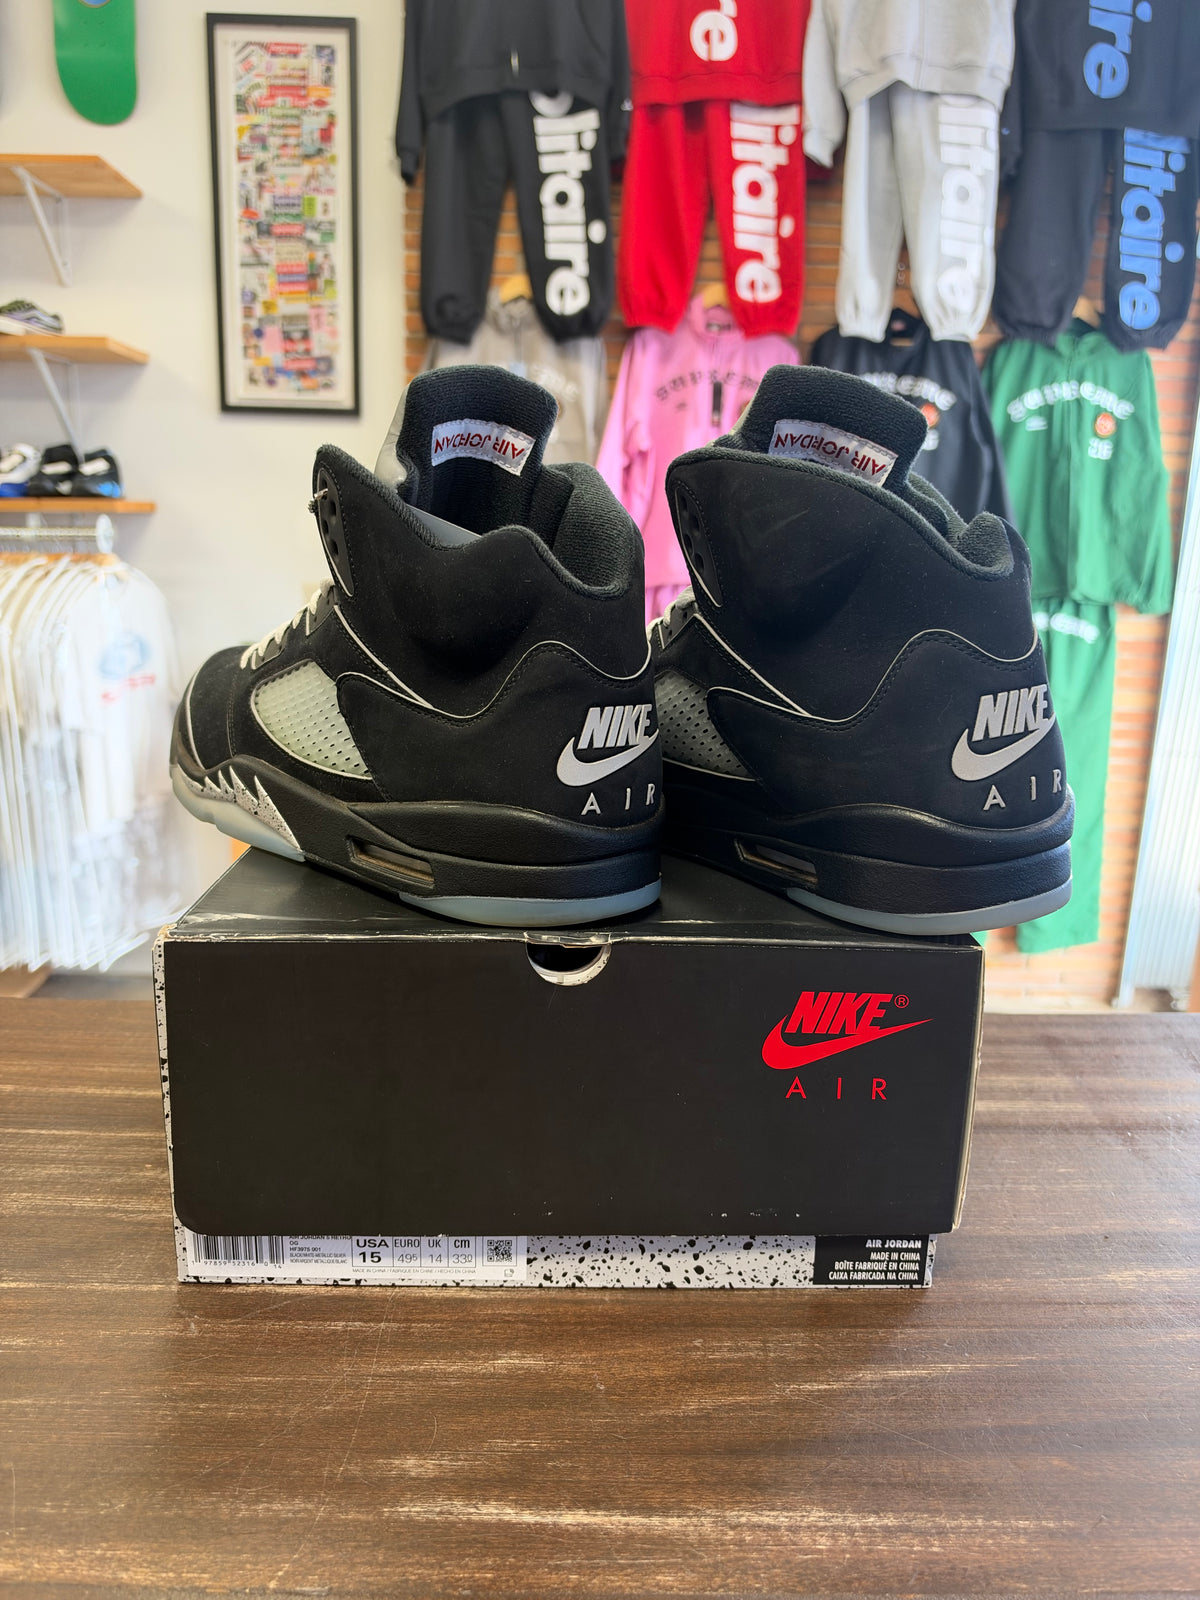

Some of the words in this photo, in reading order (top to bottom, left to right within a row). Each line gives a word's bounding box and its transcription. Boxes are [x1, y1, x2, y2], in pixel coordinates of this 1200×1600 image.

[434, 433, 491, 454] JORDAN
[492, 437, 525, 460] AIR
[774, 433, 850, 458] JORDAN
[851, 450, 886, 476] AIR
[972, 684, 1048, 741] NIKE
[577, 704, 653, 749] NIKE
[581, 783, 655, 815] AIR
[983, 769, 1062, 810] AIR
[785, 1076, 887, 1100] AIR
[356, 1239, 389, 1248] USA
[394, 1239, 420, 1248] EURO
[428, 1239, 441, 1248] UK
[454, 1239, 470, 1248] cm
[866, 1239, 882, 1248] AIR
[884, 1240, 922, 1249] JORDAN
[358, 1251, 382, 1263] 15
[429, 1254, 442, 1264] 14
[834, 1260, 853, 1270] BOÎTE
[855, 1260, 887, 1271] FABRIQUÉ
[888, 1262, 898, 1270] EN
[870, 1252, 890, 1260] MADE
[891, 1252, 898, 1260] IN
[900, 1252, 920, 1261] CHINA
[829, 1272, 848, 1280] CAIXA
[849, 1272, 885, 1280] FABRICADA
[887, 1272, 897, 1280] NA
[898, 1272, 918, 1280] CHINA
